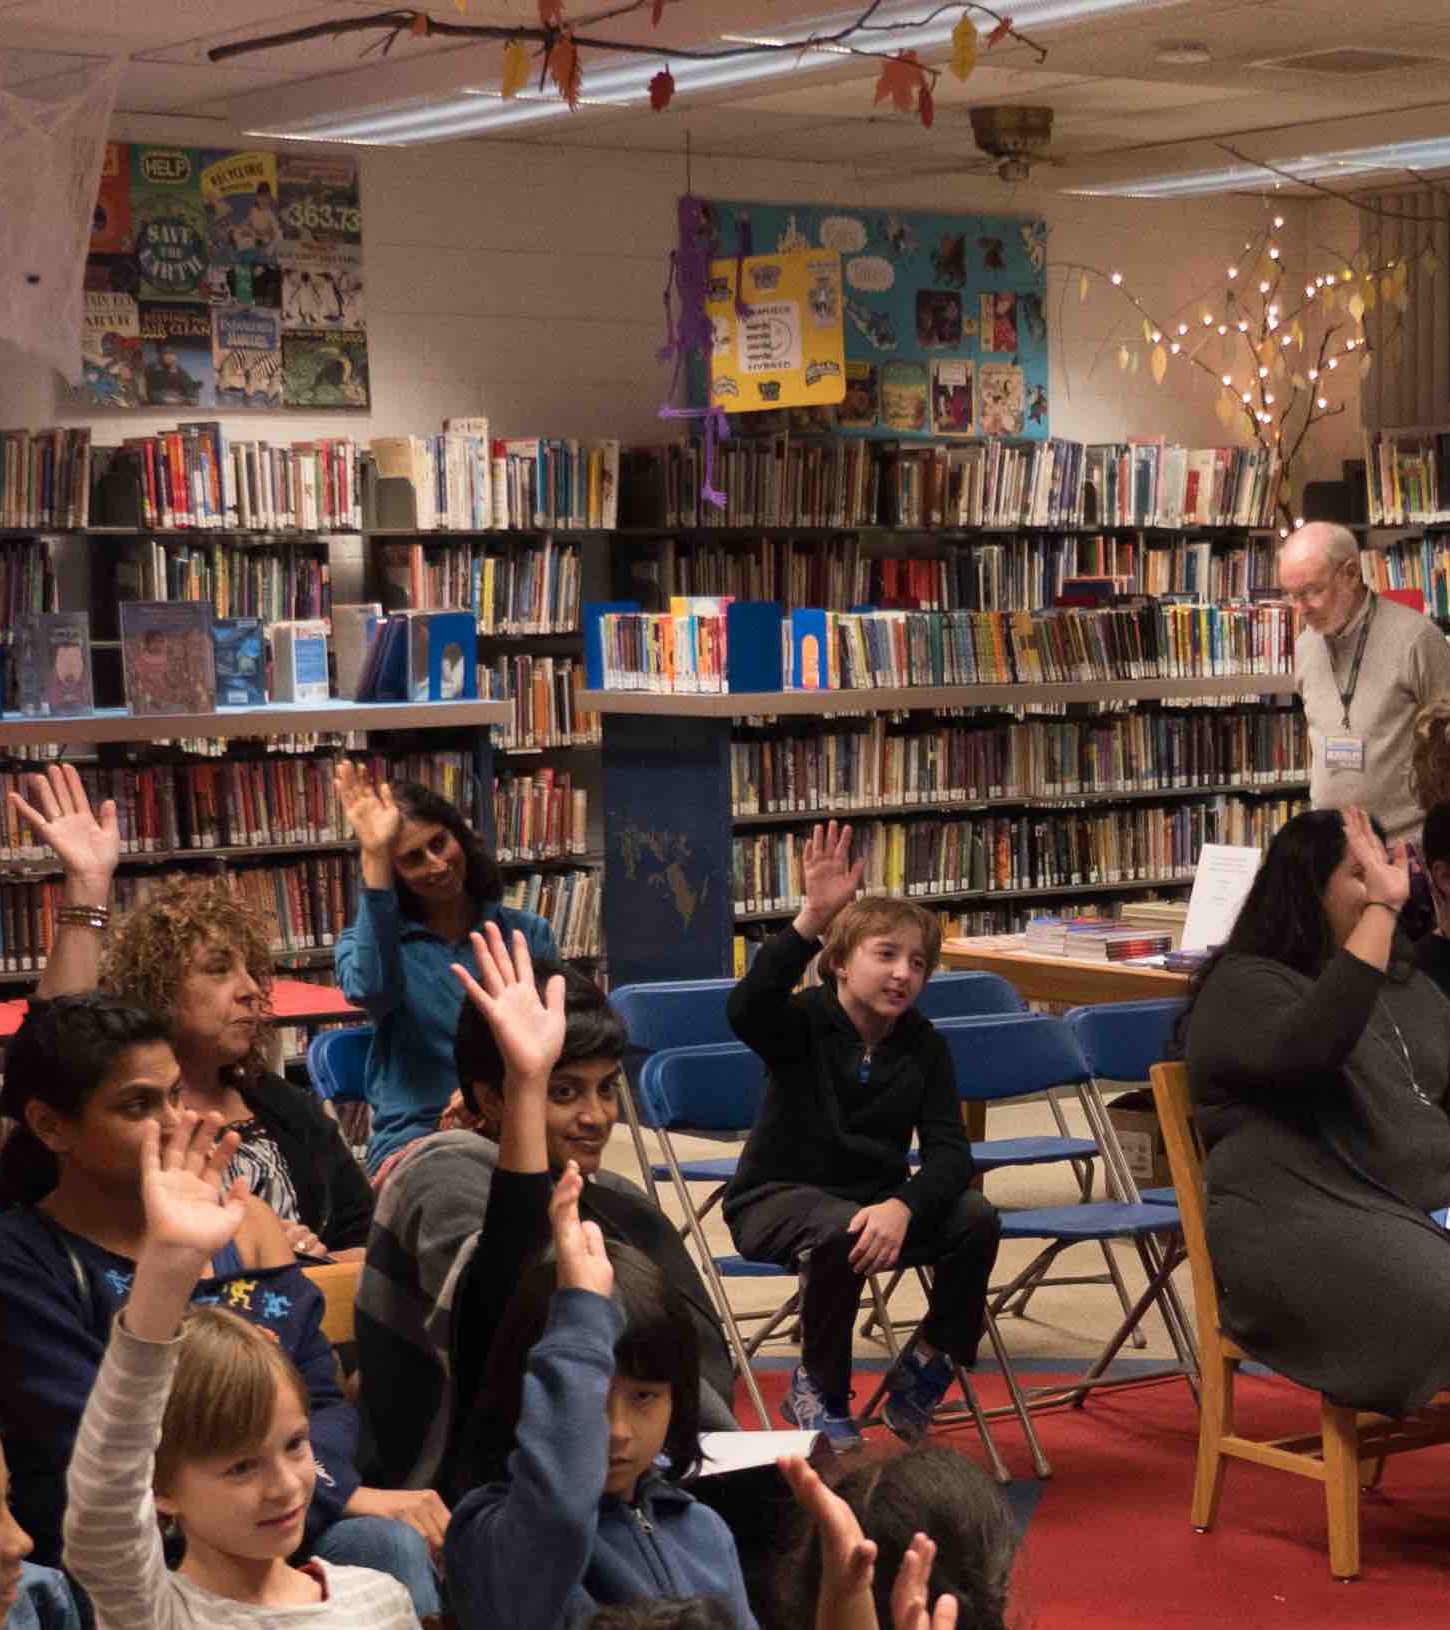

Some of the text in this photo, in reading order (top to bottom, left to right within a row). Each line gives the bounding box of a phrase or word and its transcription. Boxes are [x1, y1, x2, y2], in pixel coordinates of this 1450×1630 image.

[145, 160, 186, 177] HELP
[210, 163, 264, 186] RECYCLING
[148, 224, 193, 244] SAVE
